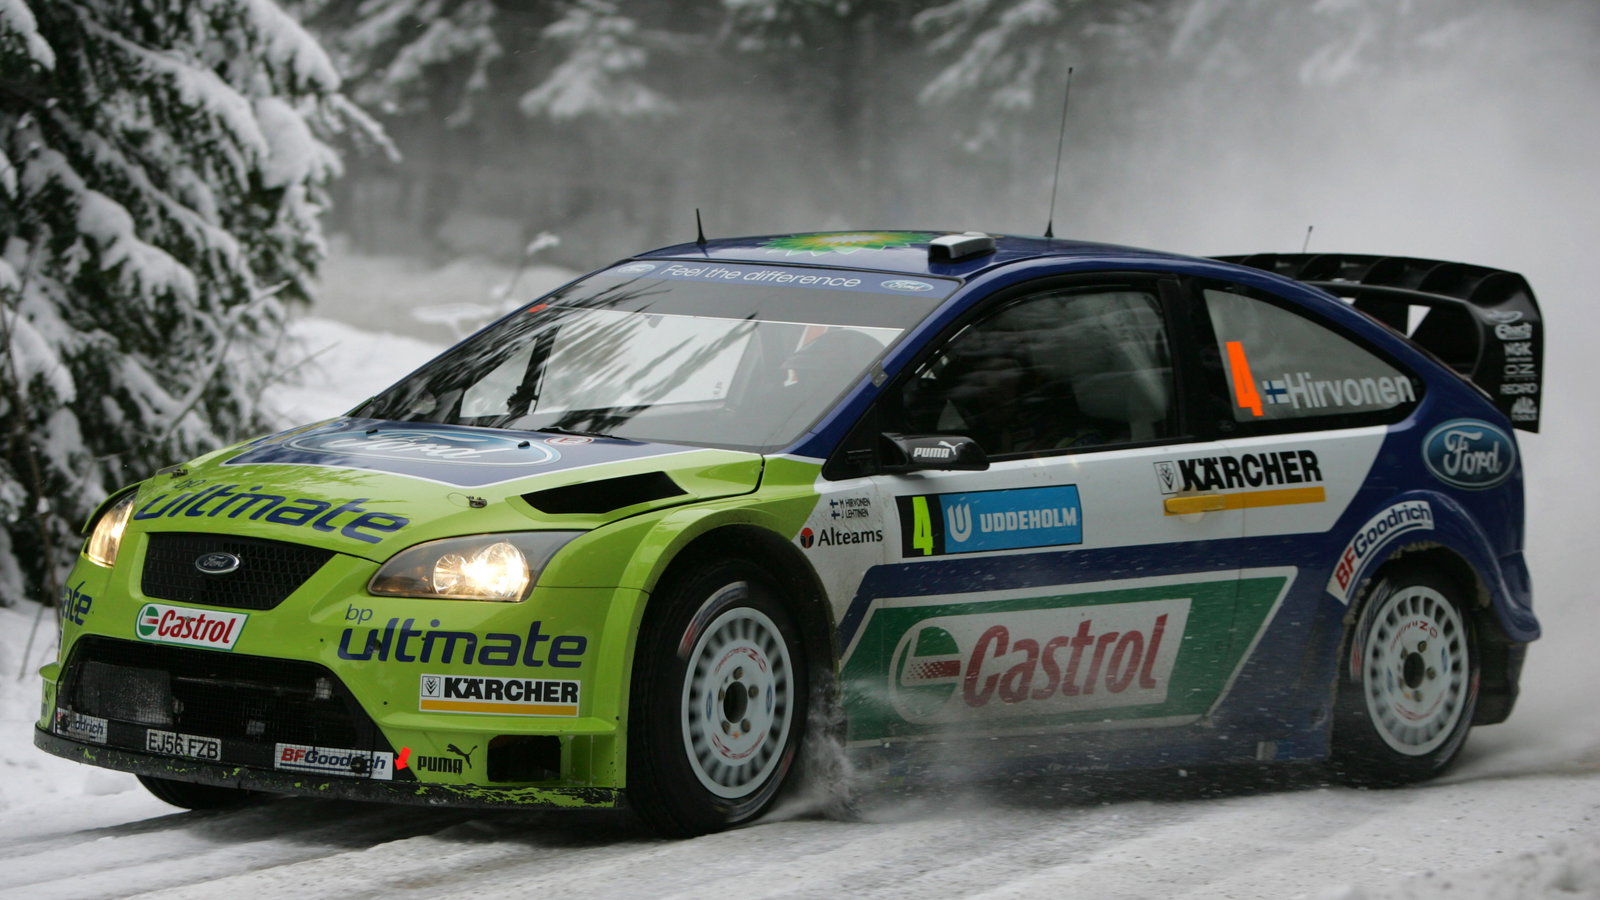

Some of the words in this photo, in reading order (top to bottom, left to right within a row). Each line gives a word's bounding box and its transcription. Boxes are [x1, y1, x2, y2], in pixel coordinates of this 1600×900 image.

[660, 264, 709, 278] Feel
[711, 267, 740, 280] the
[744, 270, 861, 288] difference
[1225, 341, 1264, 417] 4
[1284, 371, 1417, 410] Hirvonen
[913, 447, 951, 459] PUMA
[1178, 449, 1323, 492] KÄRCHER
[1443, 429, 1502, 477] Ford
[133, 484, 410, 544] ultimate
[912, 496, 934, 556] 4
[980, 507, 1077, 533] UDDEHOLM
[818, 527, 884, 547] Alteams
[1335, 504, 1432, 592] BFGoodrich
[158, 610, 236, 644] Castrol
[345, 603, 373, 624] bp
[337, 617, 588, 669] ultimate
[963, 613, 1169, 708] Castrol
[444, 676, 578, 703] KÄRCHER
[149, 732, 184, 755] EJ56
[188, 738, 219, 759] FZB
[417, 755, 463, 776] PUMA
